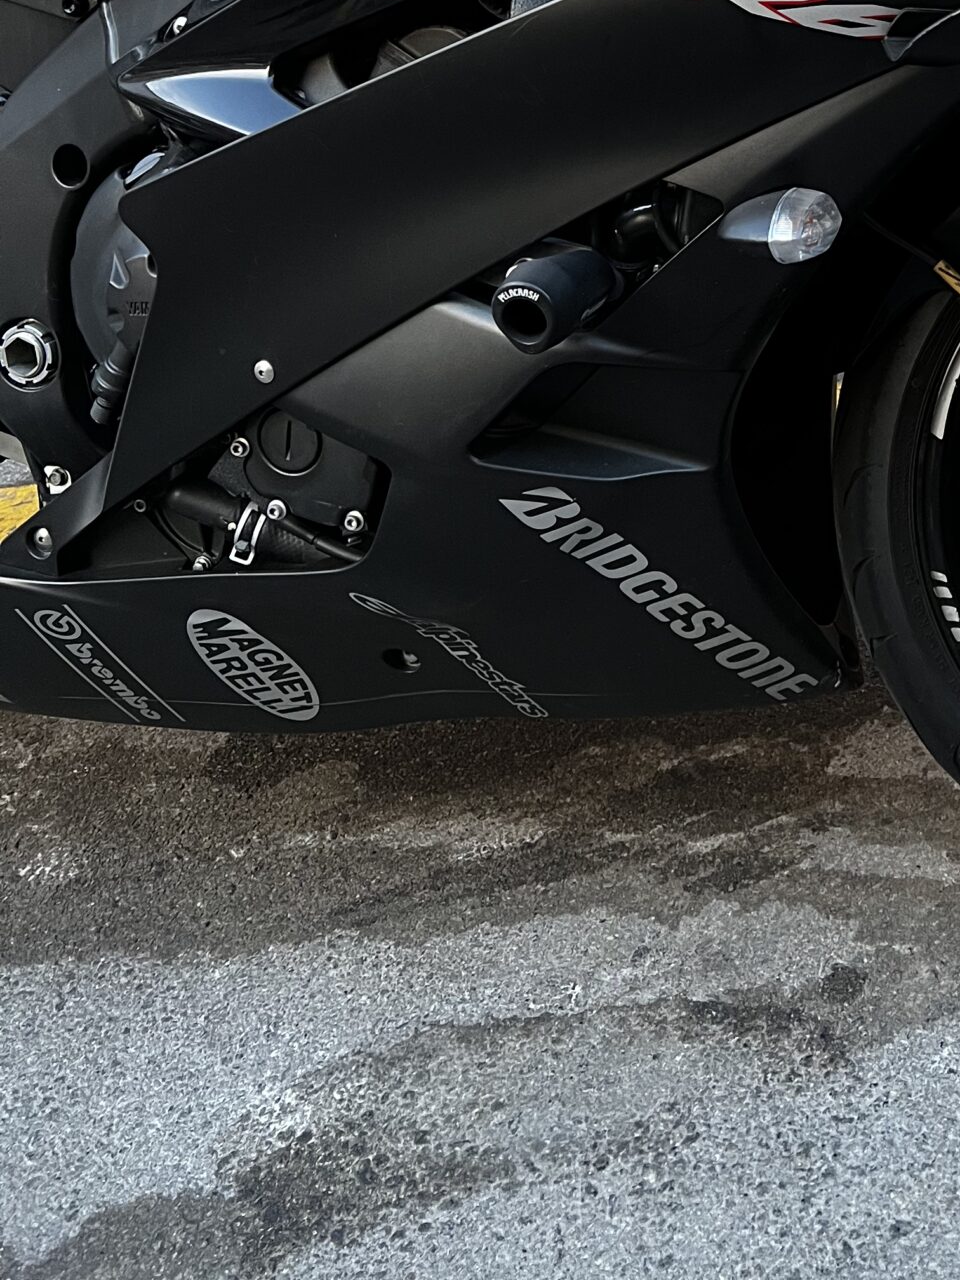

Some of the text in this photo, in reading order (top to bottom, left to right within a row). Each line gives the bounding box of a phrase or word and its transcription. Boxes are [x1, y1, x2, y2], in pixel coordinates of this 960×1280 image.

[498, 486, 819, 700] BRIDGESTONE
[65, 642, 162, 721] brembo
[193, 617, 314, 713] MAGNETI
